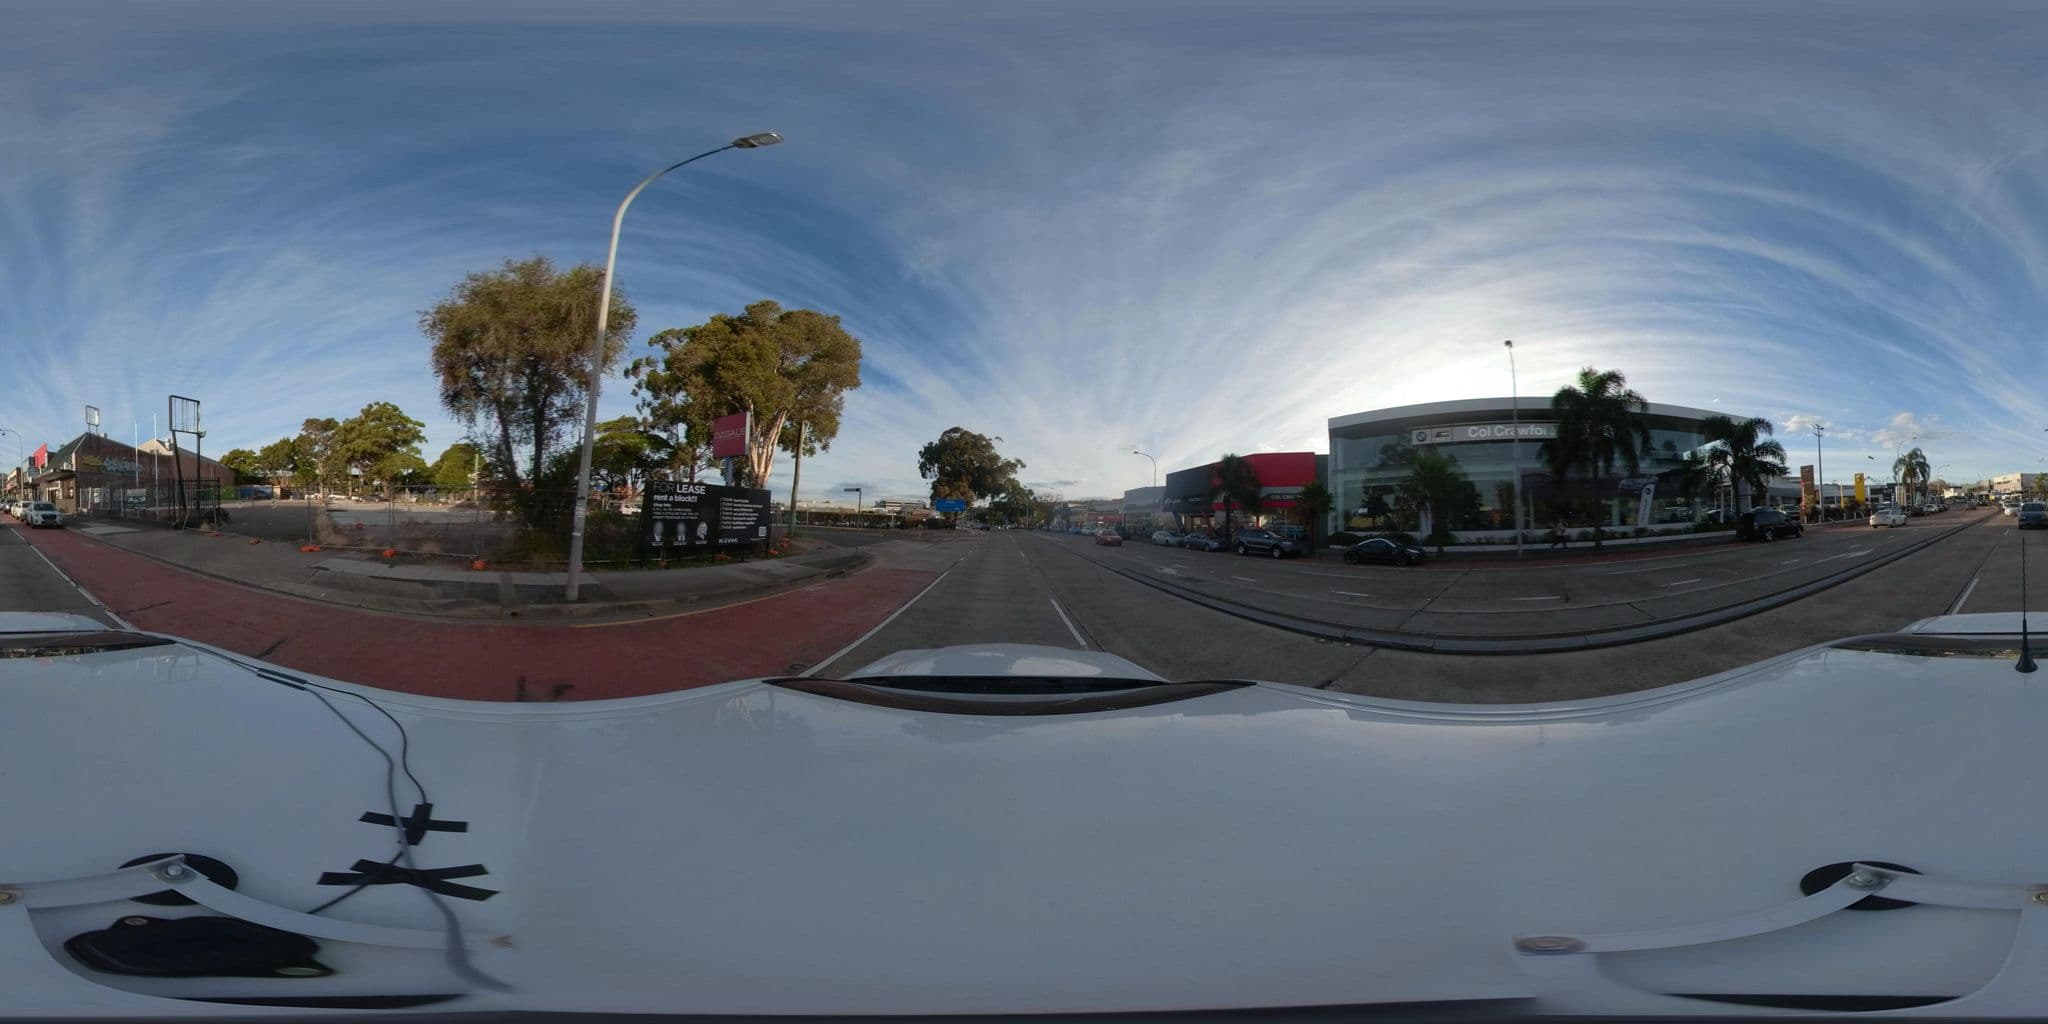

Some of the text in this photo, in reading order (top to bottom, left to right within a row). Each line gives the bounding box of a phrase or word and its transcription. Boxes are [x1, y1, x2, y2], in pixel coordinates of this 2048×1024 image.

[1468, 426, 1491, 438] Col
[653, 481, 706, 495] FOR LEASE
